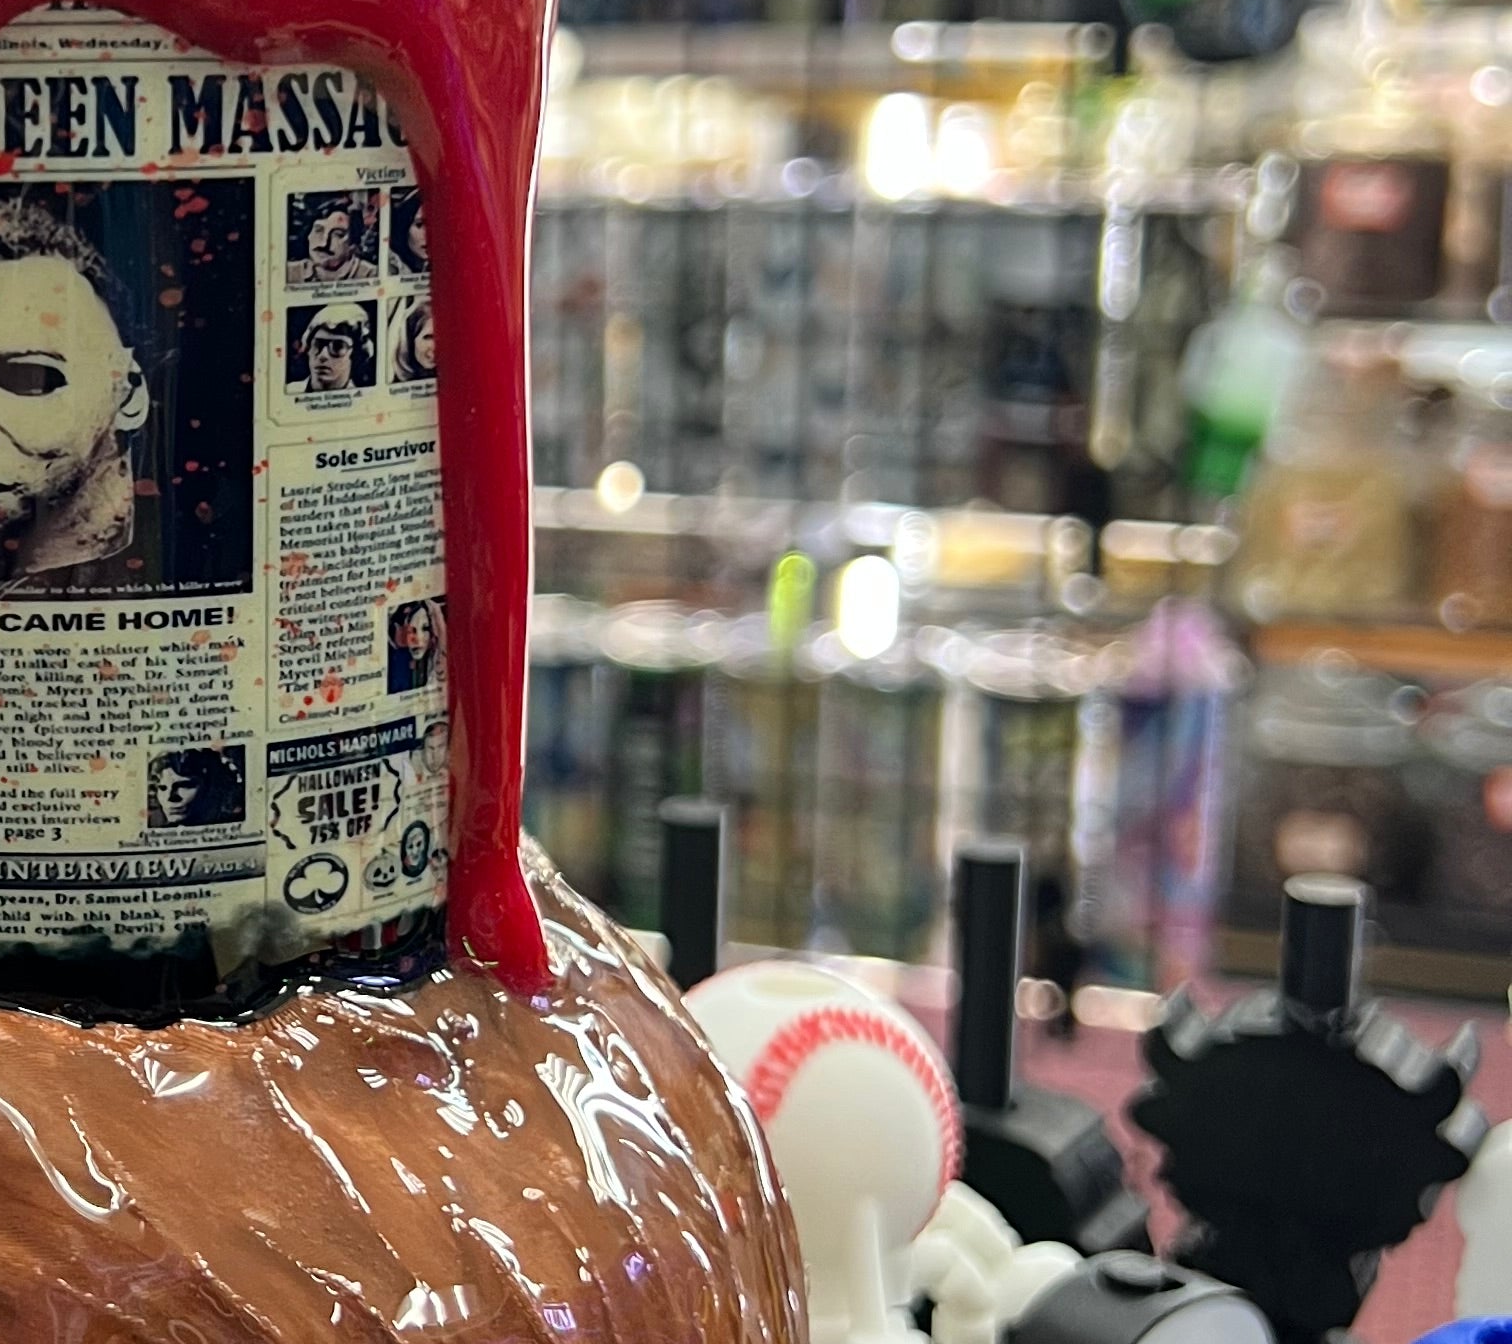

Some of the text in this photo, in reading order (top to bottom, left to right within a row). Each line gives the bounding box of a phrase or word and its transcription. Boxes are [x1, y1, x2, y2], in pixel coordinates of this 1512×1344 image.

[59, 38, 169, 51] Wednesday,
[356, 167, 406, 181] Victims
[315, 441, 436, 469] Sole Survivor
[281, 484, 323, 497] Laurie
[298, 497, 318, 509] the
[281, 505, 362, 524] murders that
[280, 517, 366, 536] been taken to
[280, 534, 343, 550] Memorial
[280, 570, 364, 589] treatment for
[116, 583, 153, 594] which
[295, 581, 371, 600] not believed
[280, 601, 326, 616] critical
[118, 606, 236, 629] HOME!
[320, 625, 343, 635] that
[33, 647, 71, 656] wore
[93, 644, 149, 655] sinister
[159, 640, 199, 654] white
[280, 633, 374, 655] Strode referred
[15, 658, 68, 669] stalked
[77, 657, 113, 669] each
[121, 656, 137, 668] of
[146, 655, 167, 667] his
[280, 645, 372, 667] to evil Michael
[35, 671, 84, 685] killing
[144, 669, 167, 681] Dr.
[175, 665, 228, 679] Samuel
[280, 666, 323, 680] Myers
[46, 679, 214, 698] Myers psychiatrist of
[31, 691, 229, 709] tracked his patient down
[15, 709, 52, 724] night
[62, 709, 90, 721] and
[100, 708, 131, 721] shot
[141, 706, 169, 719] him
[178, 706, 188, 717] 6
[34, 722, 104, 737] (pictured
[109, 719, 161, 734] below)
[169, 717, 228, 733] escaped
[11, 735, 64, 751] bloody
[73, 736, 114, 748] scene
[124, 736, 138, 747] at
[148, 730, 212, 748] Lampkin
[220, 729, 254, 740] Lane
[269, 724, 413, 764] NICHOLS HARDWARE
[15, 749, 28, 760] is
[37, 747, 101, 760] believed
[110, 751, 126, 760] to
[6, 760, 38, 774] still
[44, 760, 85, 774] alive.
[298, 762, 381, 793] HALLOWEEN
[21, 787, 45, 800] the
[50, 787, 75, 799] full
[80, 788, 119, 802] story
[11, 800, 81, 812] exclusive
[297, 784, 381, 824] SALE!
[42, 814, 121, 825] interviews
[4, 827, 45, 842] page
[51, 827, 62, 841] 3
[309, 814, 372, 845] 75% OFF
[0, 892, 50, 907] years,
[55, 893, 81, 906] Dr.
[85, 889, 147, 905] Samuel
[40, 911, 74, 922] with
[83, 910, 111, 922] this
[120, 909, 165, 922] blank,
[114, 922, 165, 934] Devil's
